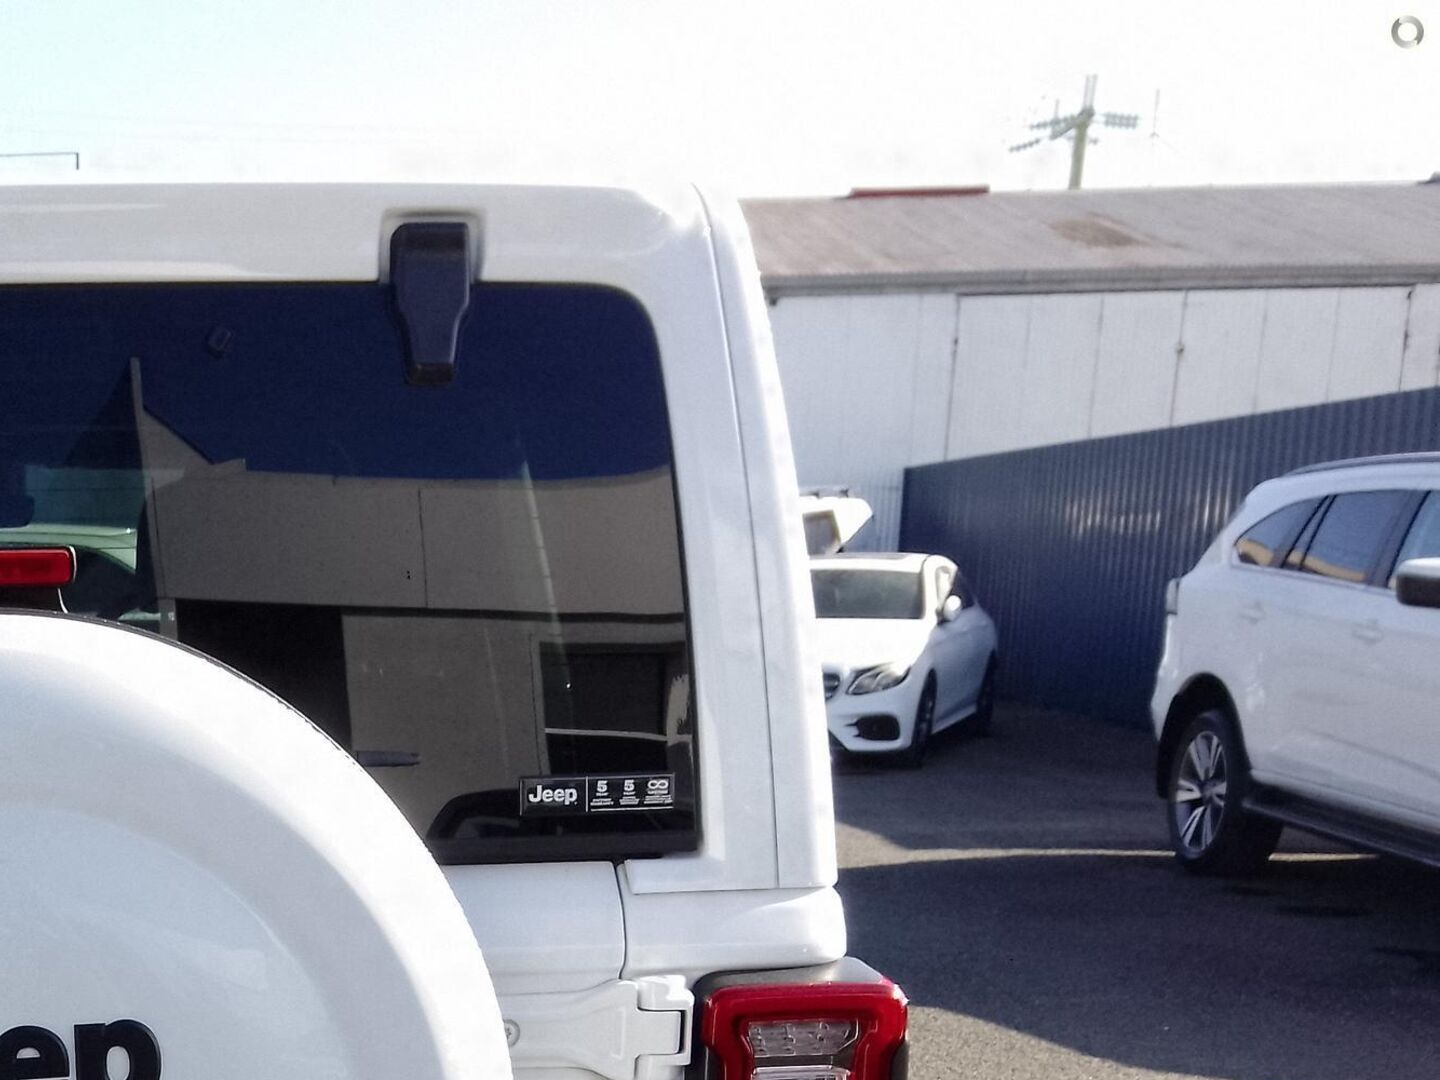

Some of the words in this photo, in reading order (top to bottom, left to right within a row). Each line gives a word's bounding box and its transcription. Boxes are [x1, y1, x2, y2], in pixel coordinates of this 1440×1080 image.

[596, 780, 608, 793] 5
[624, 779, 635, 791] 5
[528, 785, 578, 805] Jeep
